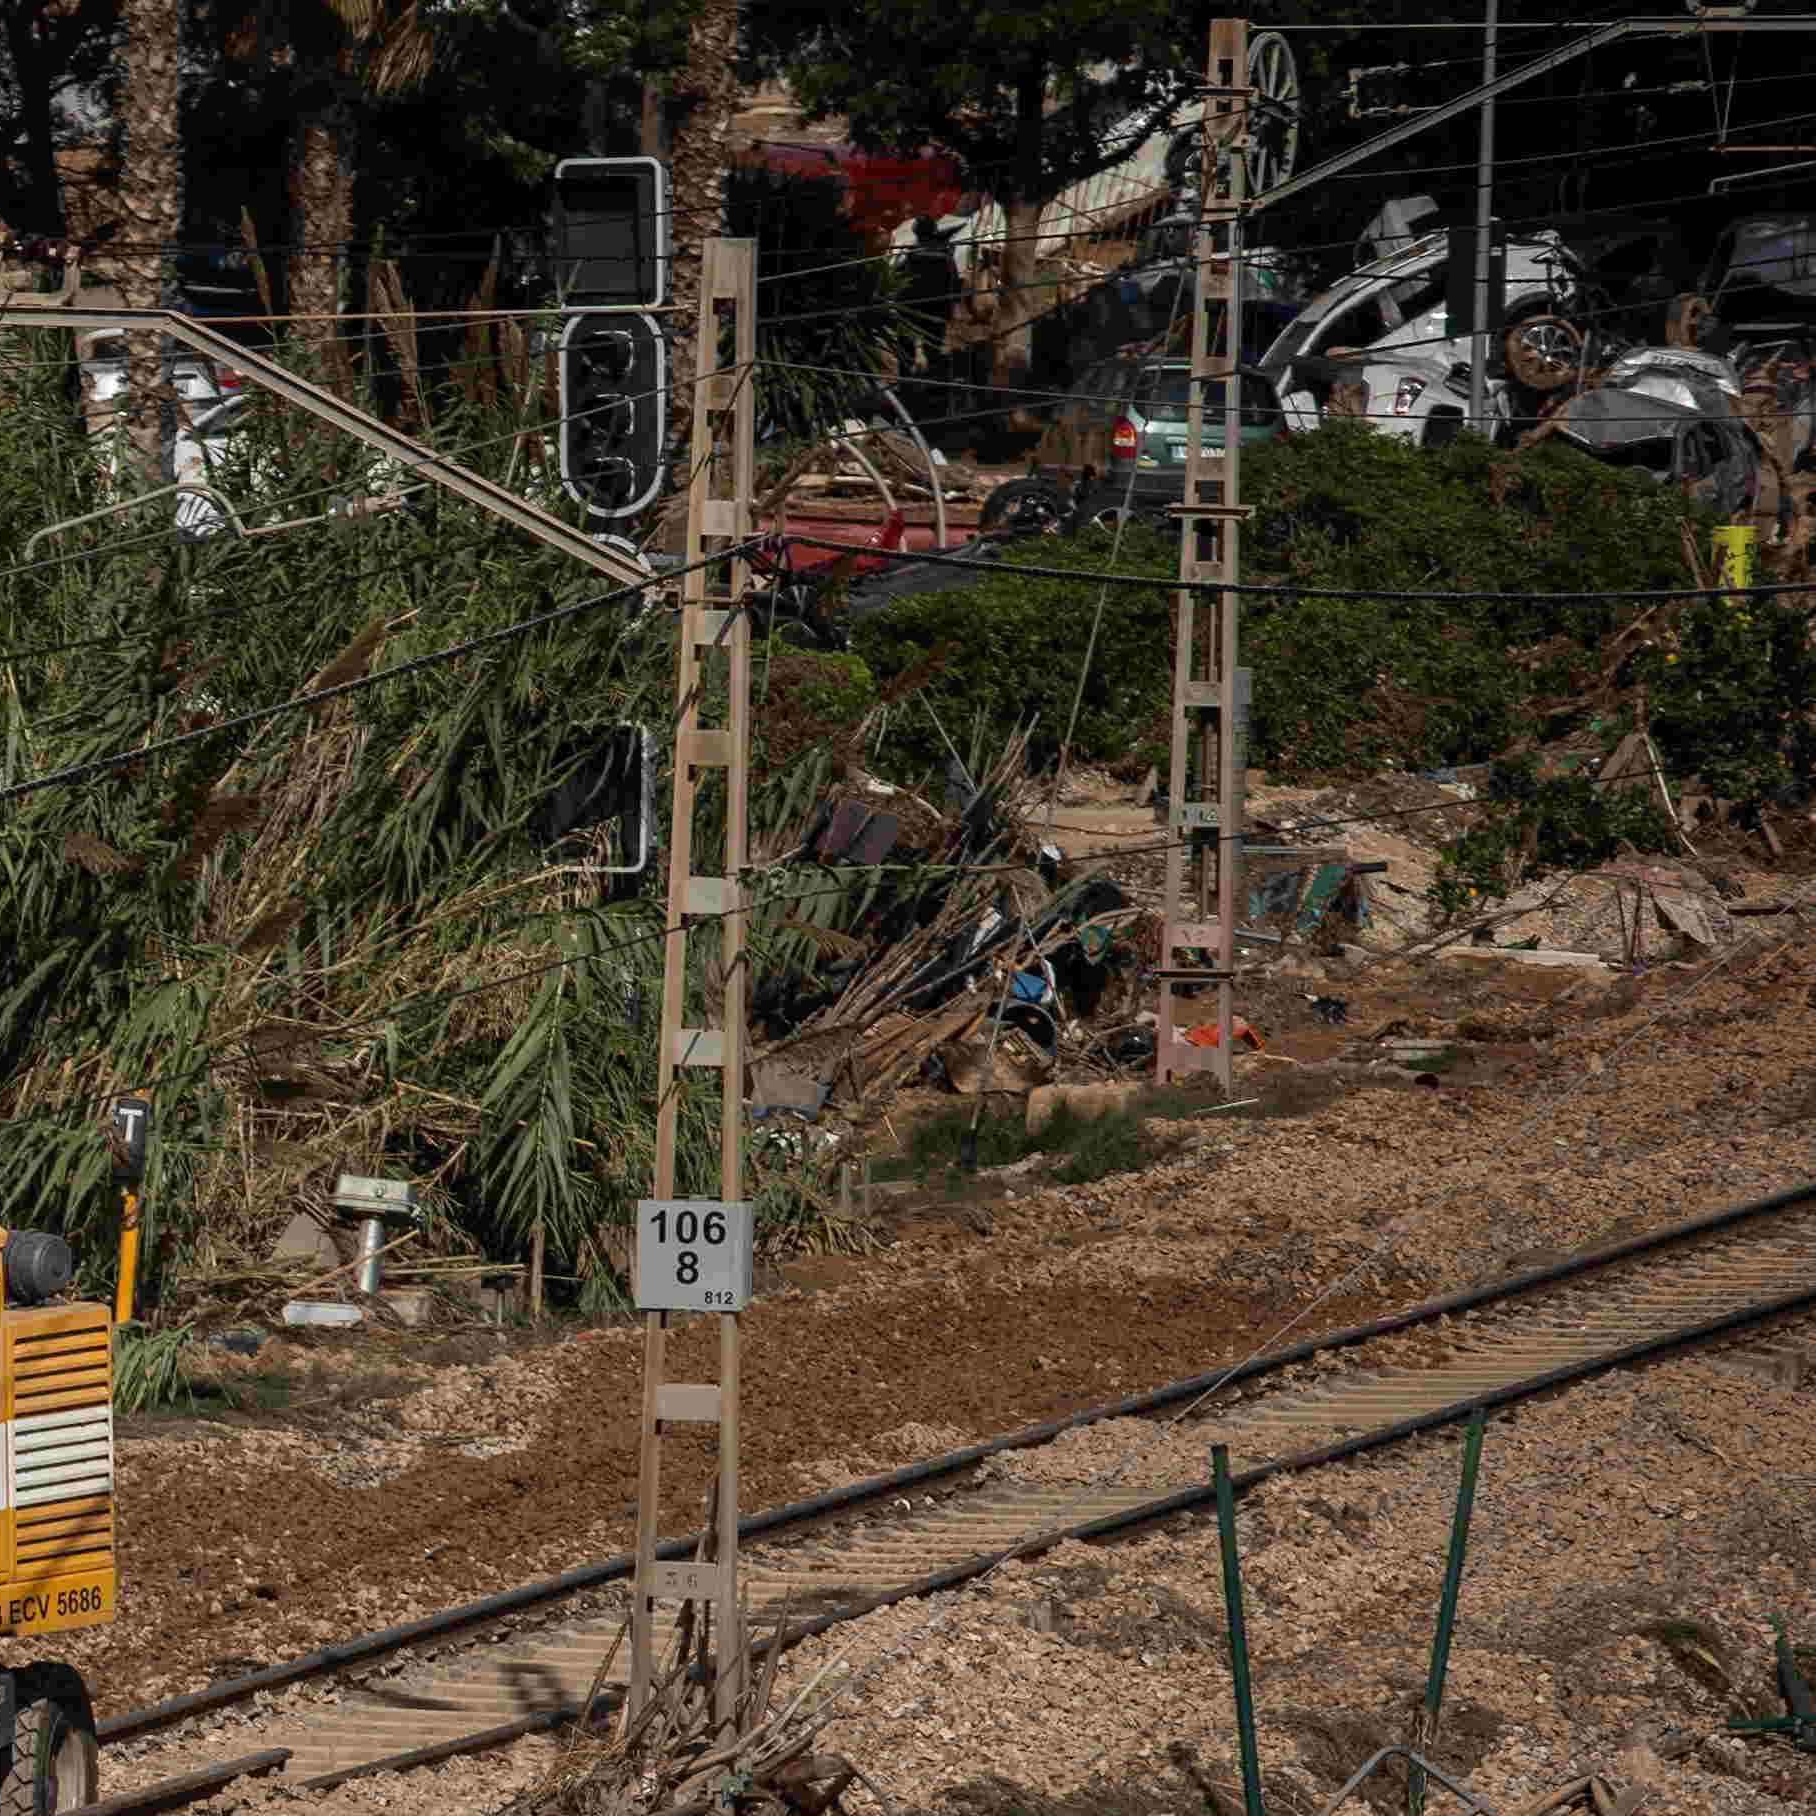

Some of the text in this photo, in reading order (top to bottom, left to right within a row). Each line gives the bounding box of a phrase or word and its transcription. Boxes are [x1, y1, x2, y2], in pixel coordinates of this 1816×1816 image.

[119, 1107, 144, 1142] T
[650, 1210, 726, 1245] 106
[676, 1251, 699, 1285] 8
[704, 1290, 734, 1305] 812
[9, 1594, 50, 1625] ECV
[56, 1584, 103, 1616] 5686
